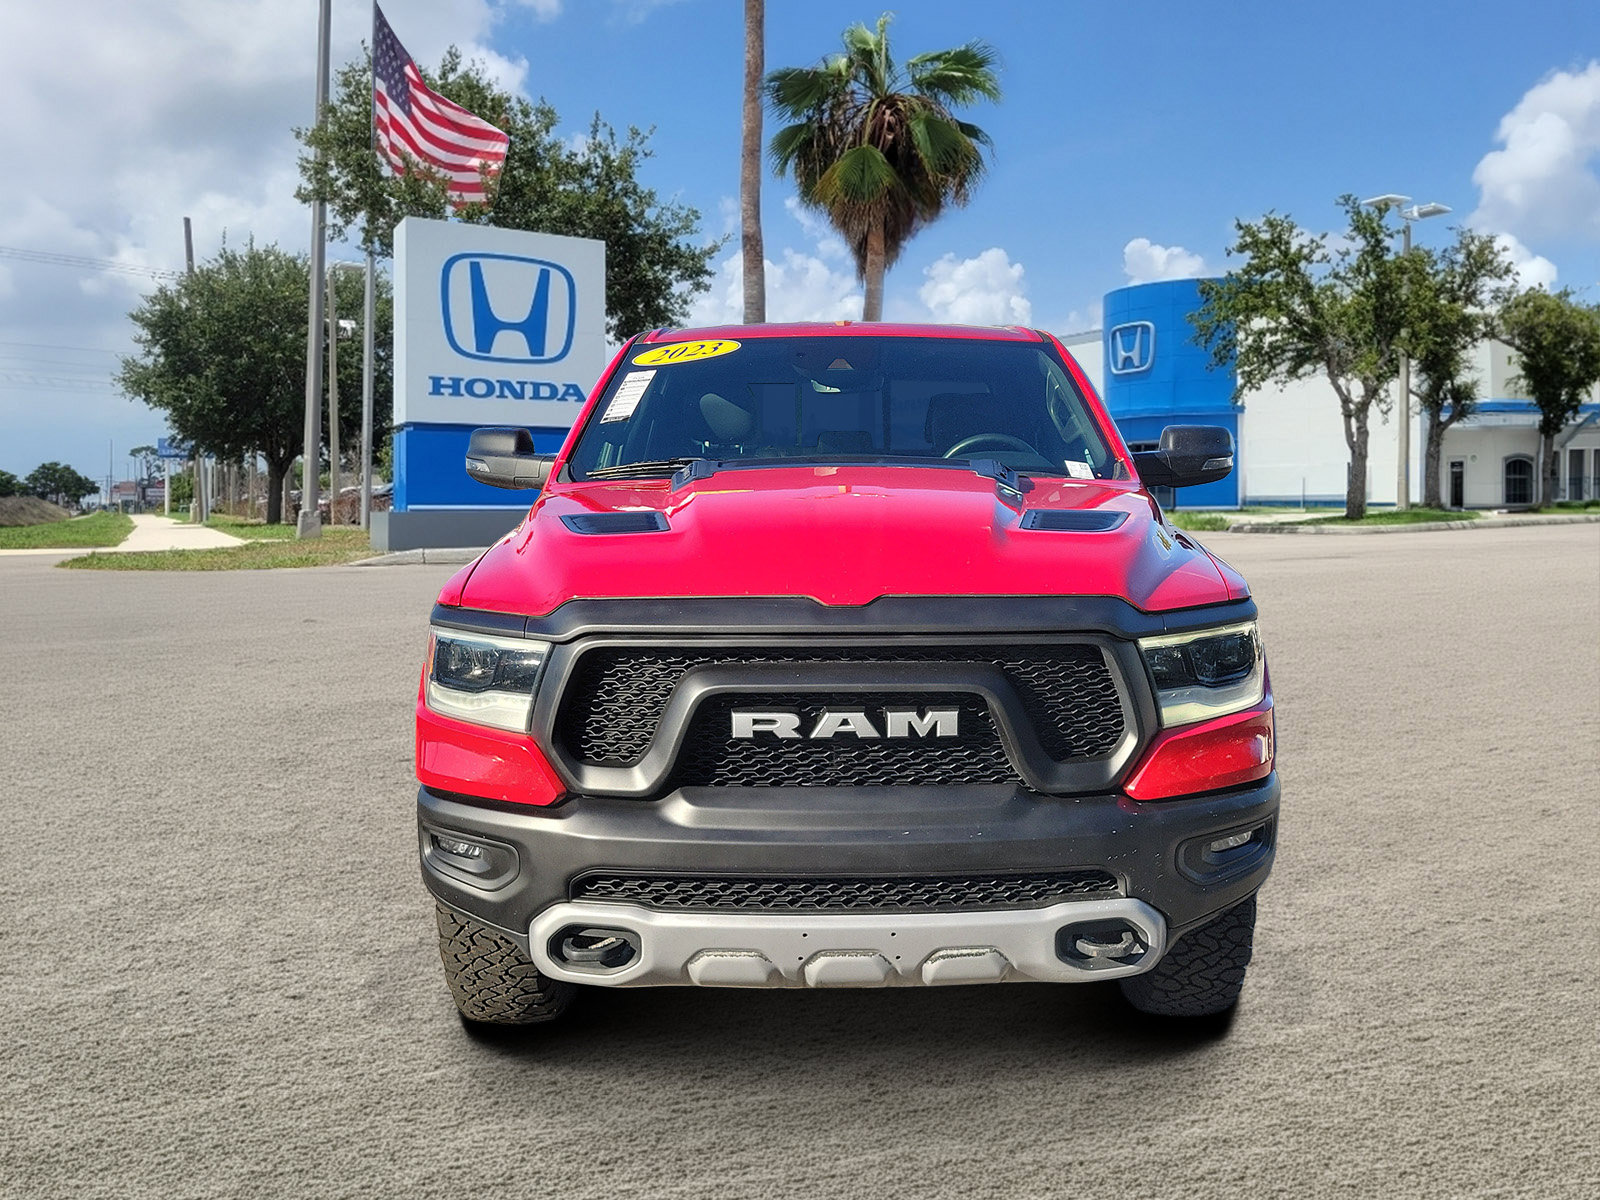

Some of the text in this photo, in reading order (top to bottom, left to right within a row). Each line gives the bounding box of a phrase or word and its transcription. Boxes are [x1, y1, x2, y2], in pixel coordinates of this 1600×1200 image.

[648, 342, 724, 363] 2023
[428, 376, 587, 403] HONDA
[731, 706, 960, 738] RAM
